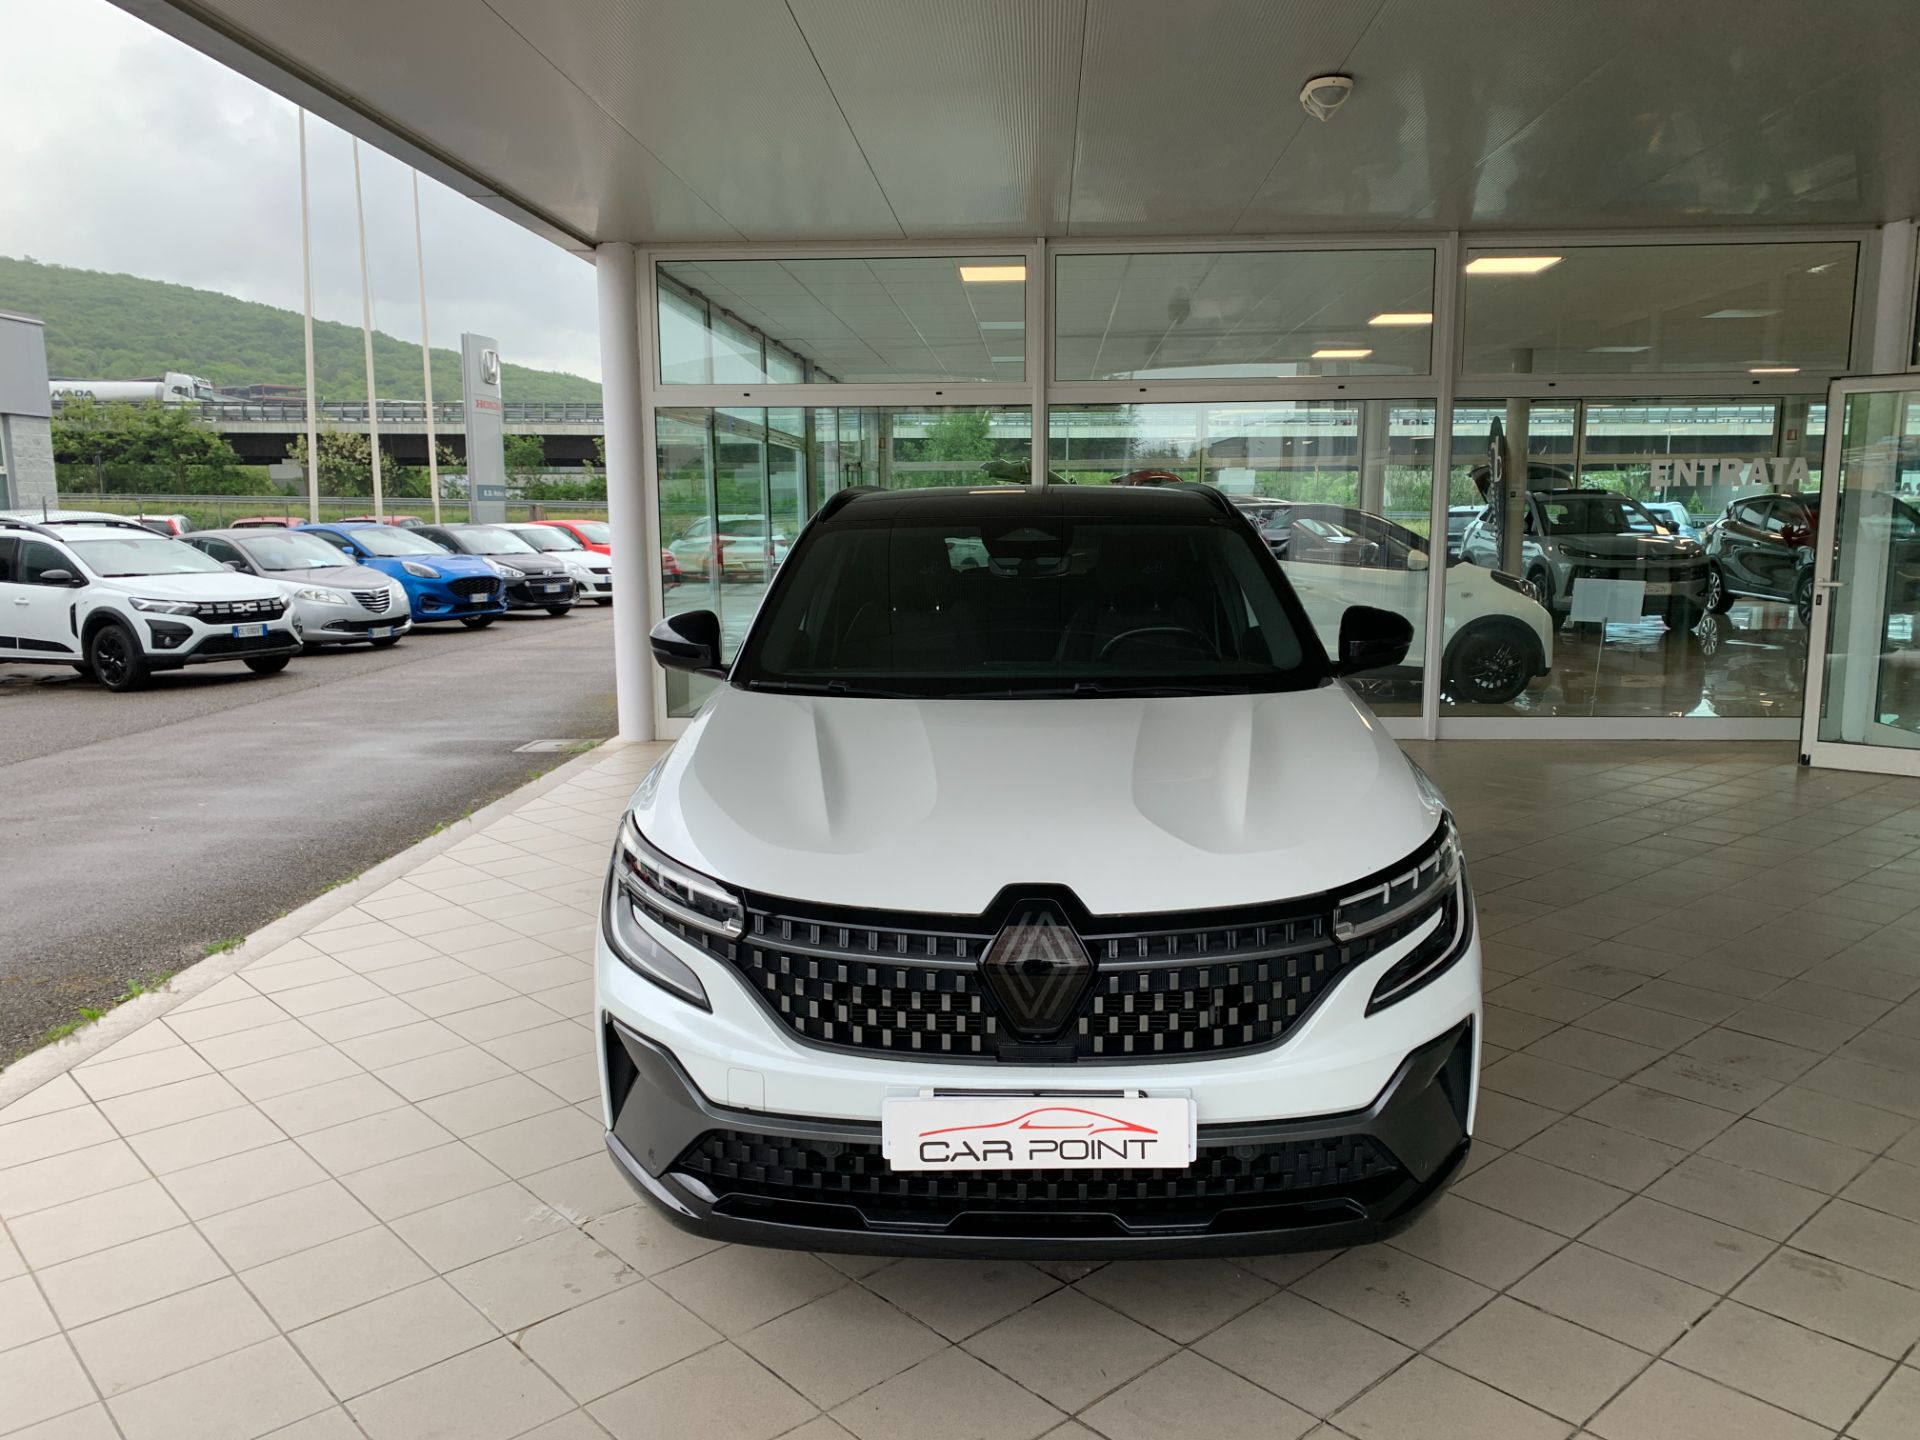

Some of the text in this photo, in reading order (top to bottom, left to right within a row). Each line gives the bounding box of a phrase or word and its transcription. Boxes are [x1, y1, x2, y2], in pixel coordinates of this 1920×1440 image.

[1650, 456, 1812, 487] ENTRATA
[919, 1138, 1158, 1163] CAR POINT
